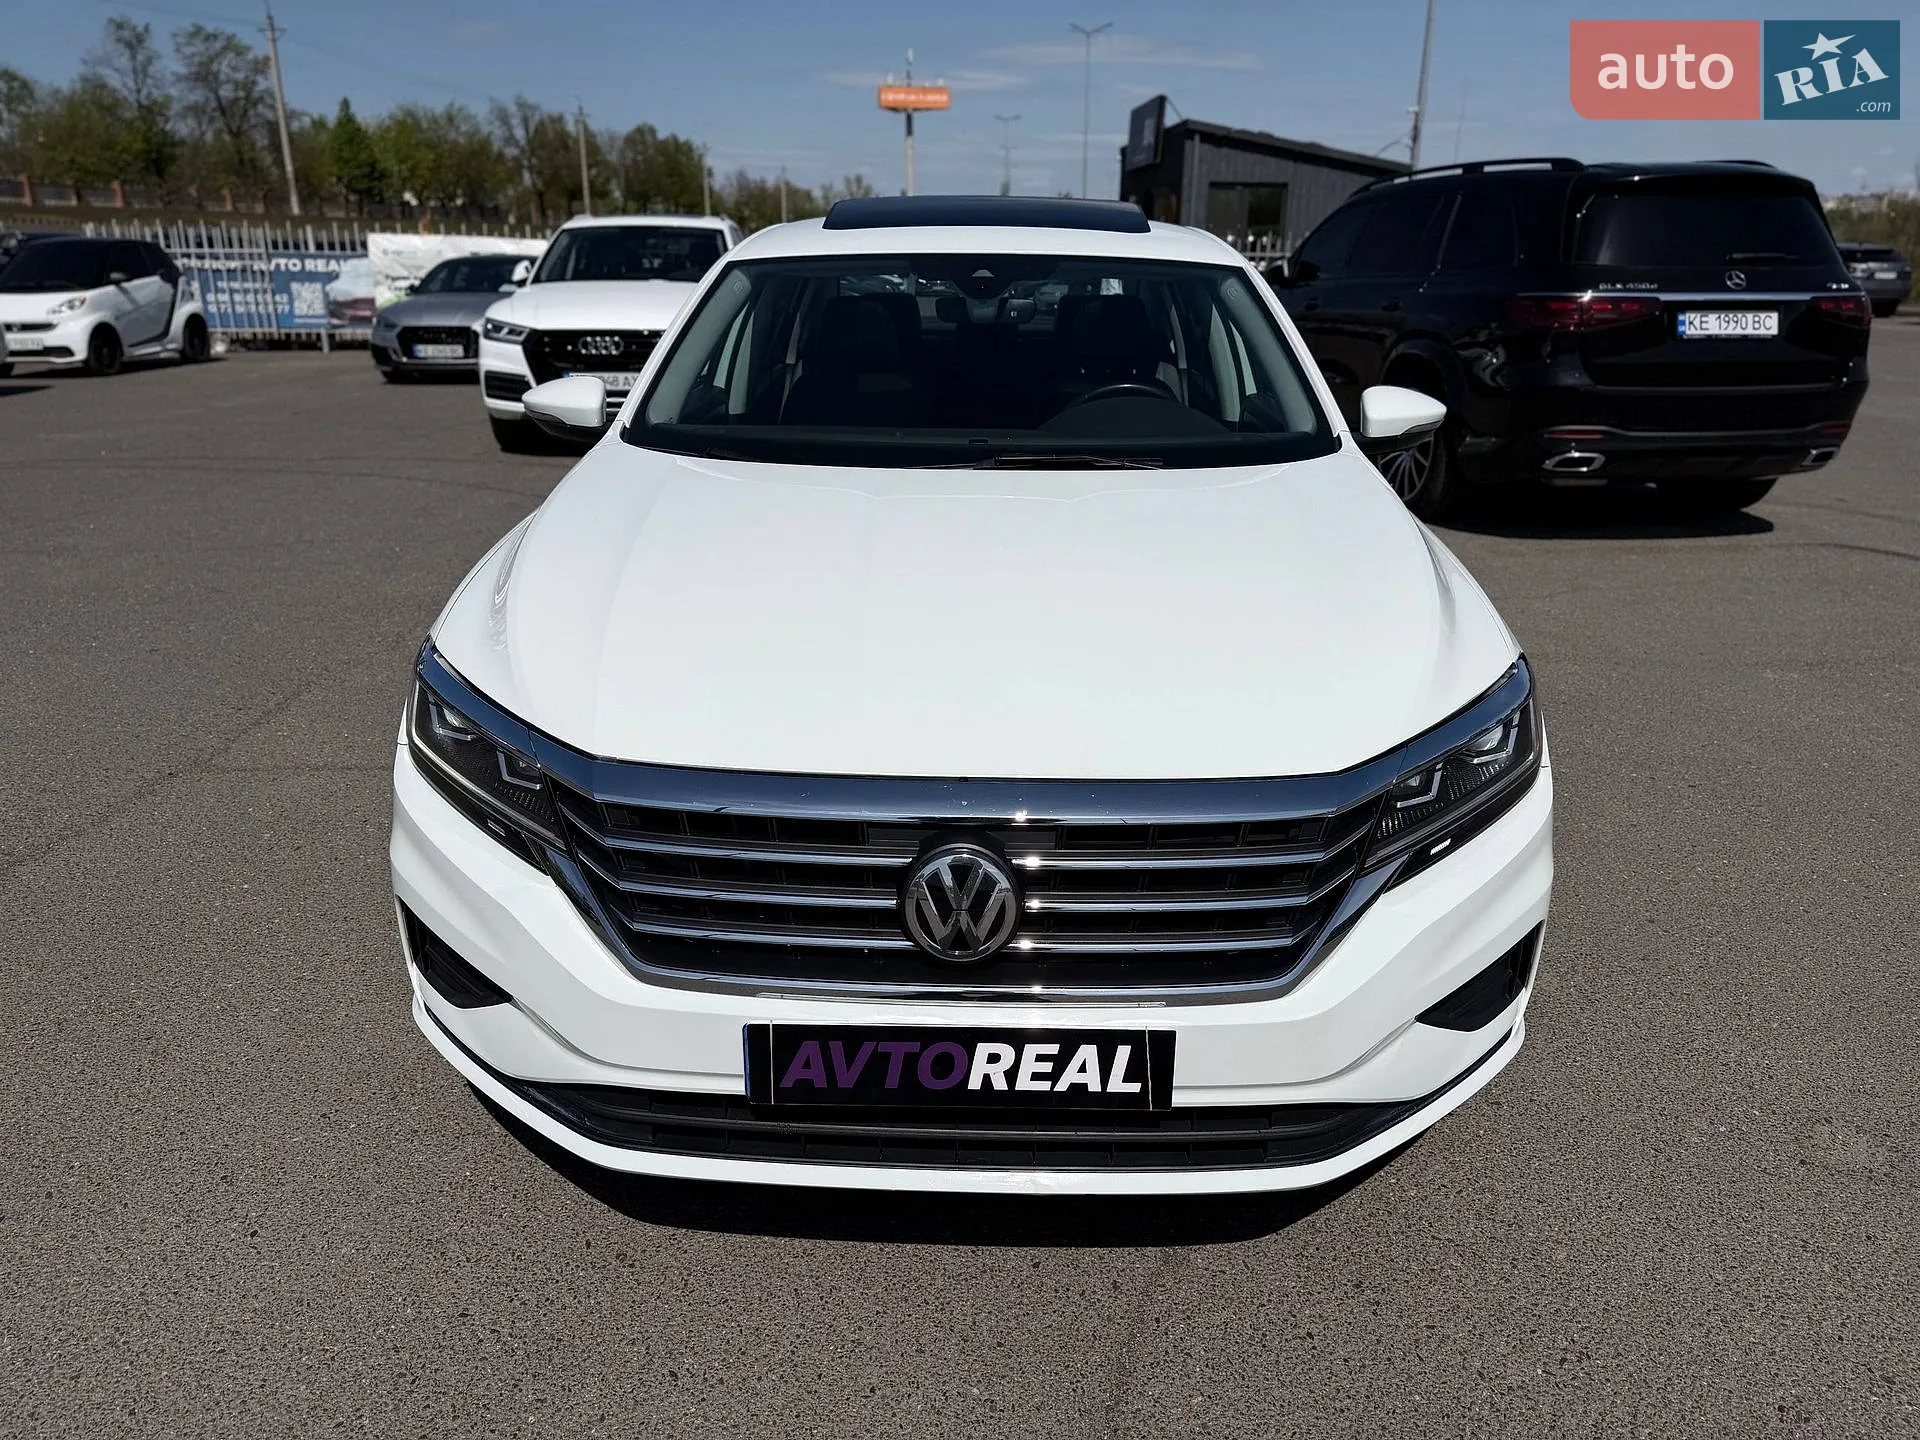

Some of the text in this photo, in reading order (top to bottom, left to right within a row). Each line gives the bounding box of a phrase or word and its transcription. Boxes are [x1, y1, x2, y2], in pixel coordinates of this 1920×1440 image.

[1687, 313, 1709, 331] KE
[1714, 313, 1748, 331] 1990
[1752, 313, 1773, 331] BC
[780, 1040, 1143, 1094] AVTOREAL
